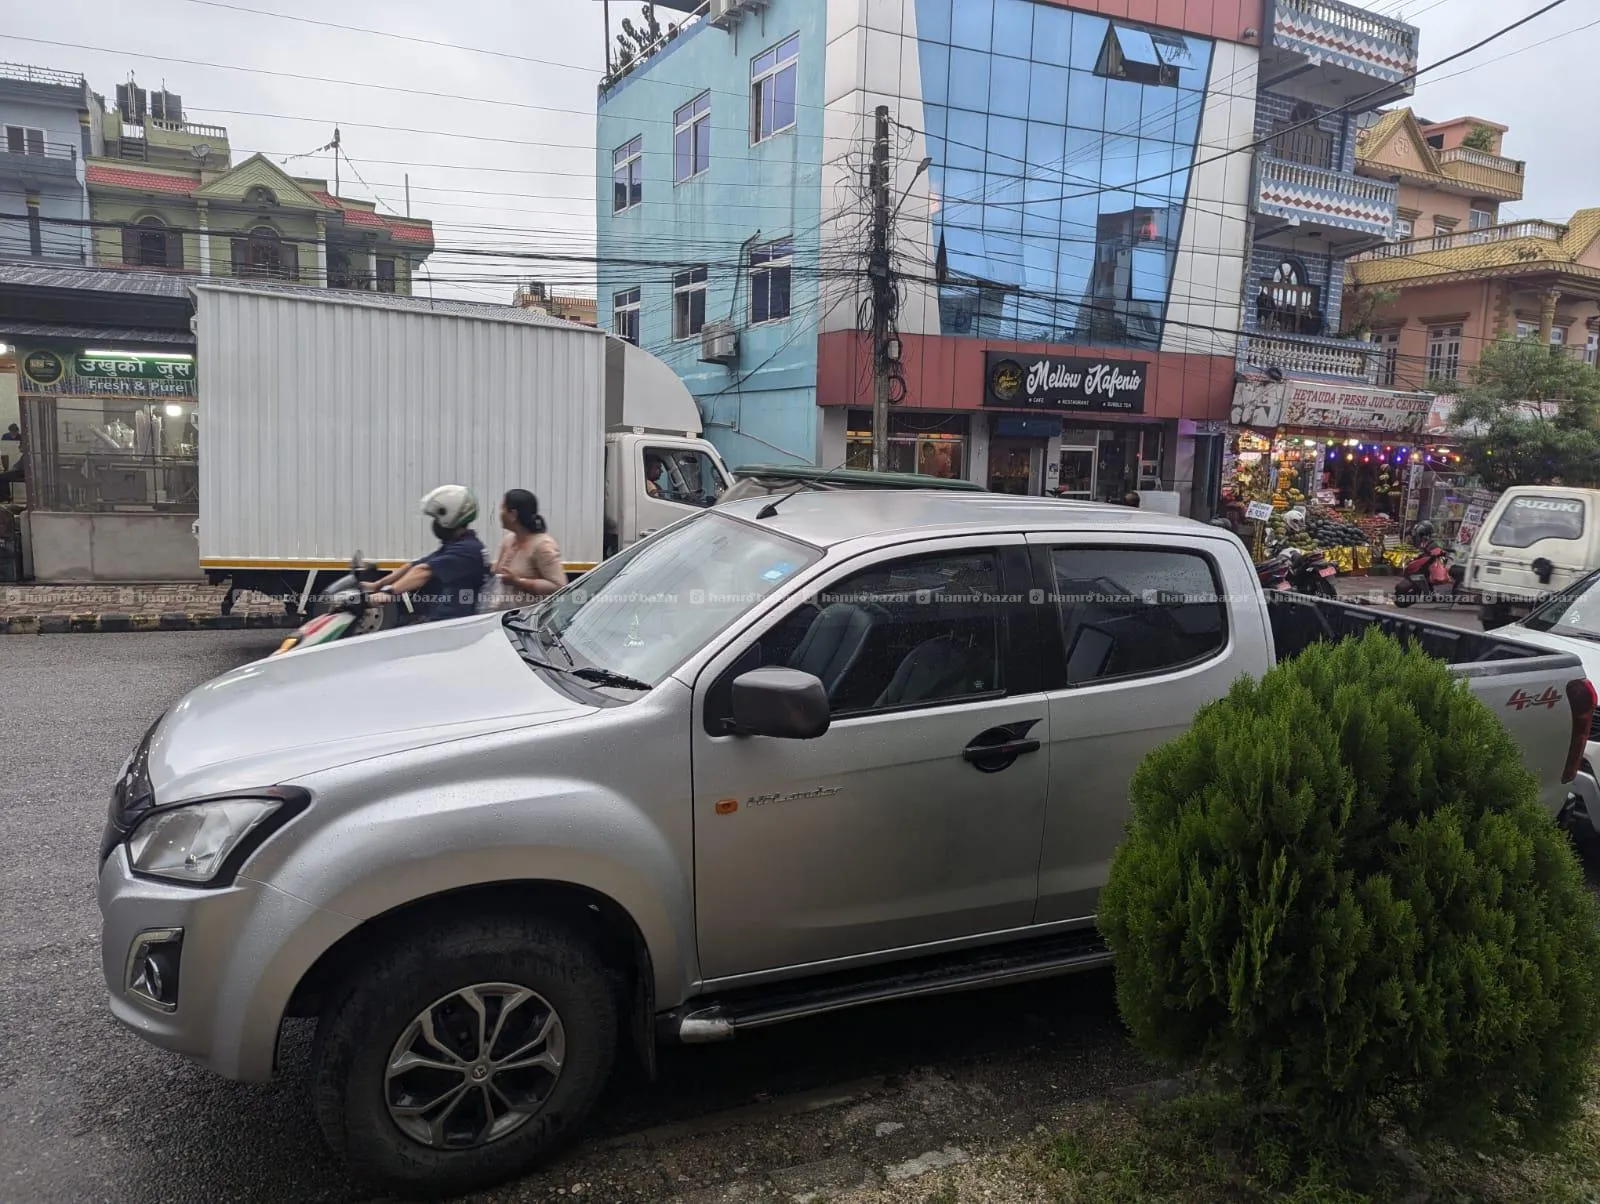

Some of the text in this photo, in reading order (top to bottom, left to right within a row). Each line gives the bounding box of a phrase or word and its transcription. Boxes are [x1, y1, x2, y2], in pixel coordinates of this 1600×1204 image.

[78, 357, 145, 376] उखुको
[154, 361, 192, 379] जुस
[1026, 360, 1082, 394] Mellow
[1084, 364, 1142, 398] Kafenio
[89, 379, 185, 393] Fresh & Pure
[1293, 388, 1336, 405] HETAUDA
[1337, 393, 1369, 406] FRESH
[1369, 396, 1395, 409] JUICE
[1395, 399, 1430, 411] CENTRE
[1514, 499, 1581, 513] SUZUKI
[1505, 685, 1563, 711] 4x4
